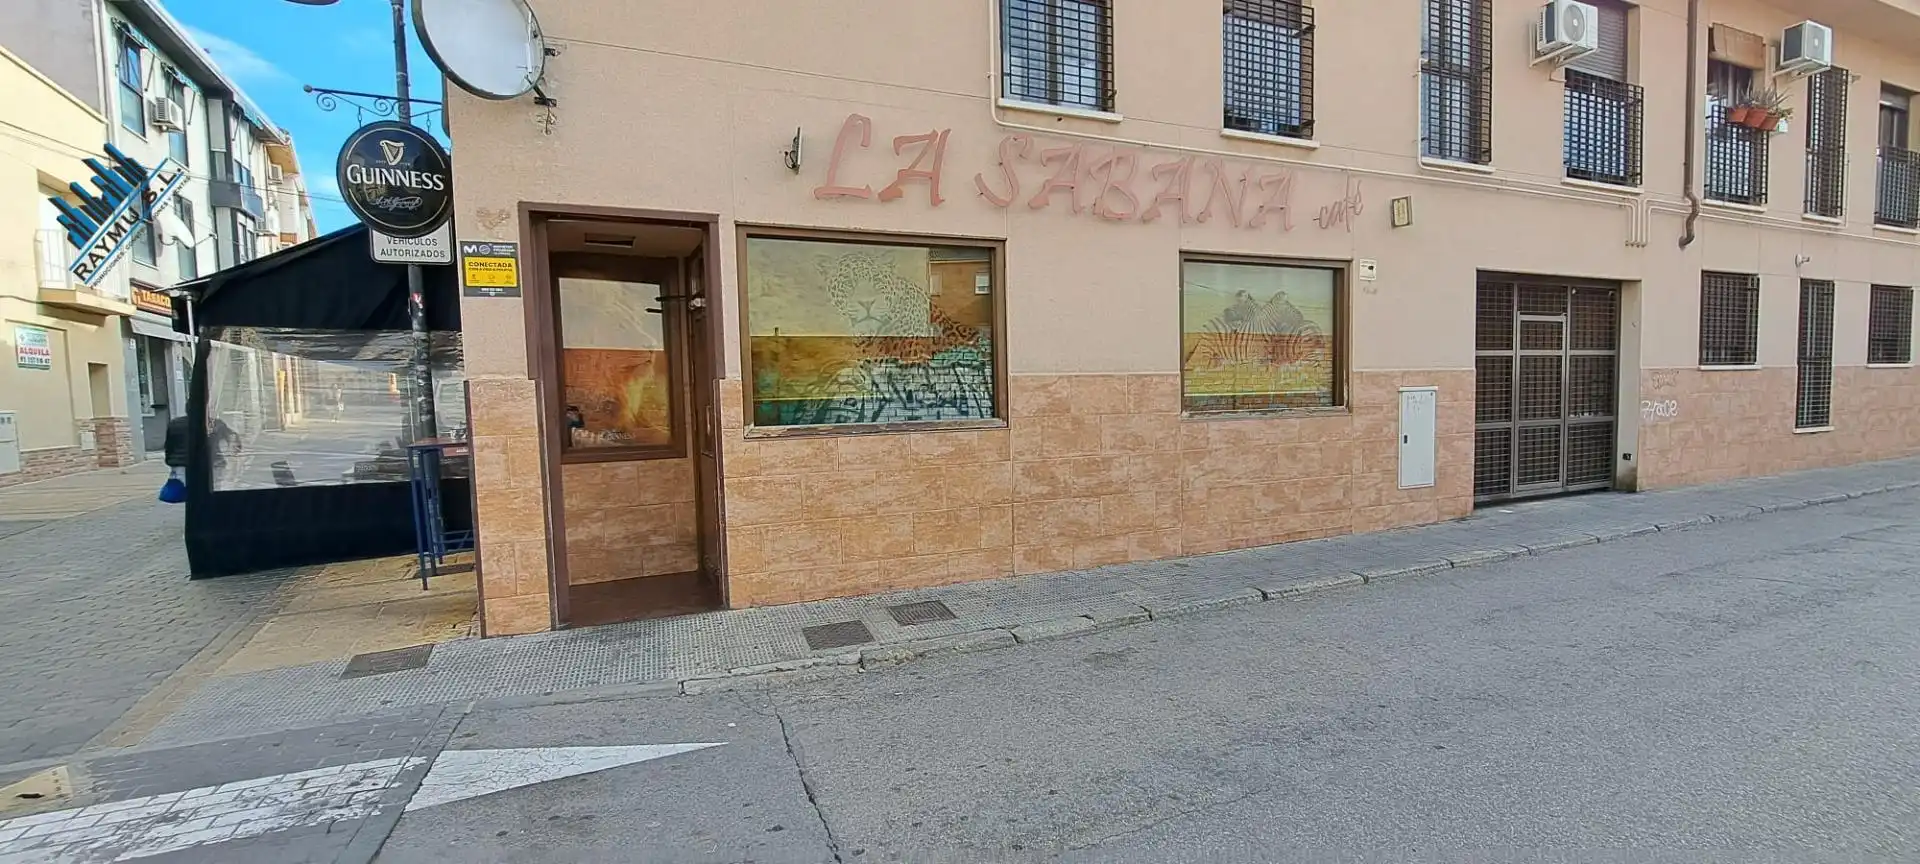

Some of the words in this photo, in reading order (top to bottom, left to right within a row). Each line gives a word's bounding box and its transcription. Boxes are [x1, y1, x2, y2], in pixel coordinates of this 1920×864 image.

[346, 164, 444, 191] GUINNESS
[813, 113, 951, 207] LA
[974, 133, 1295, 231] SABANA
[380, 248, 446, 258] AUTORIZADOS
